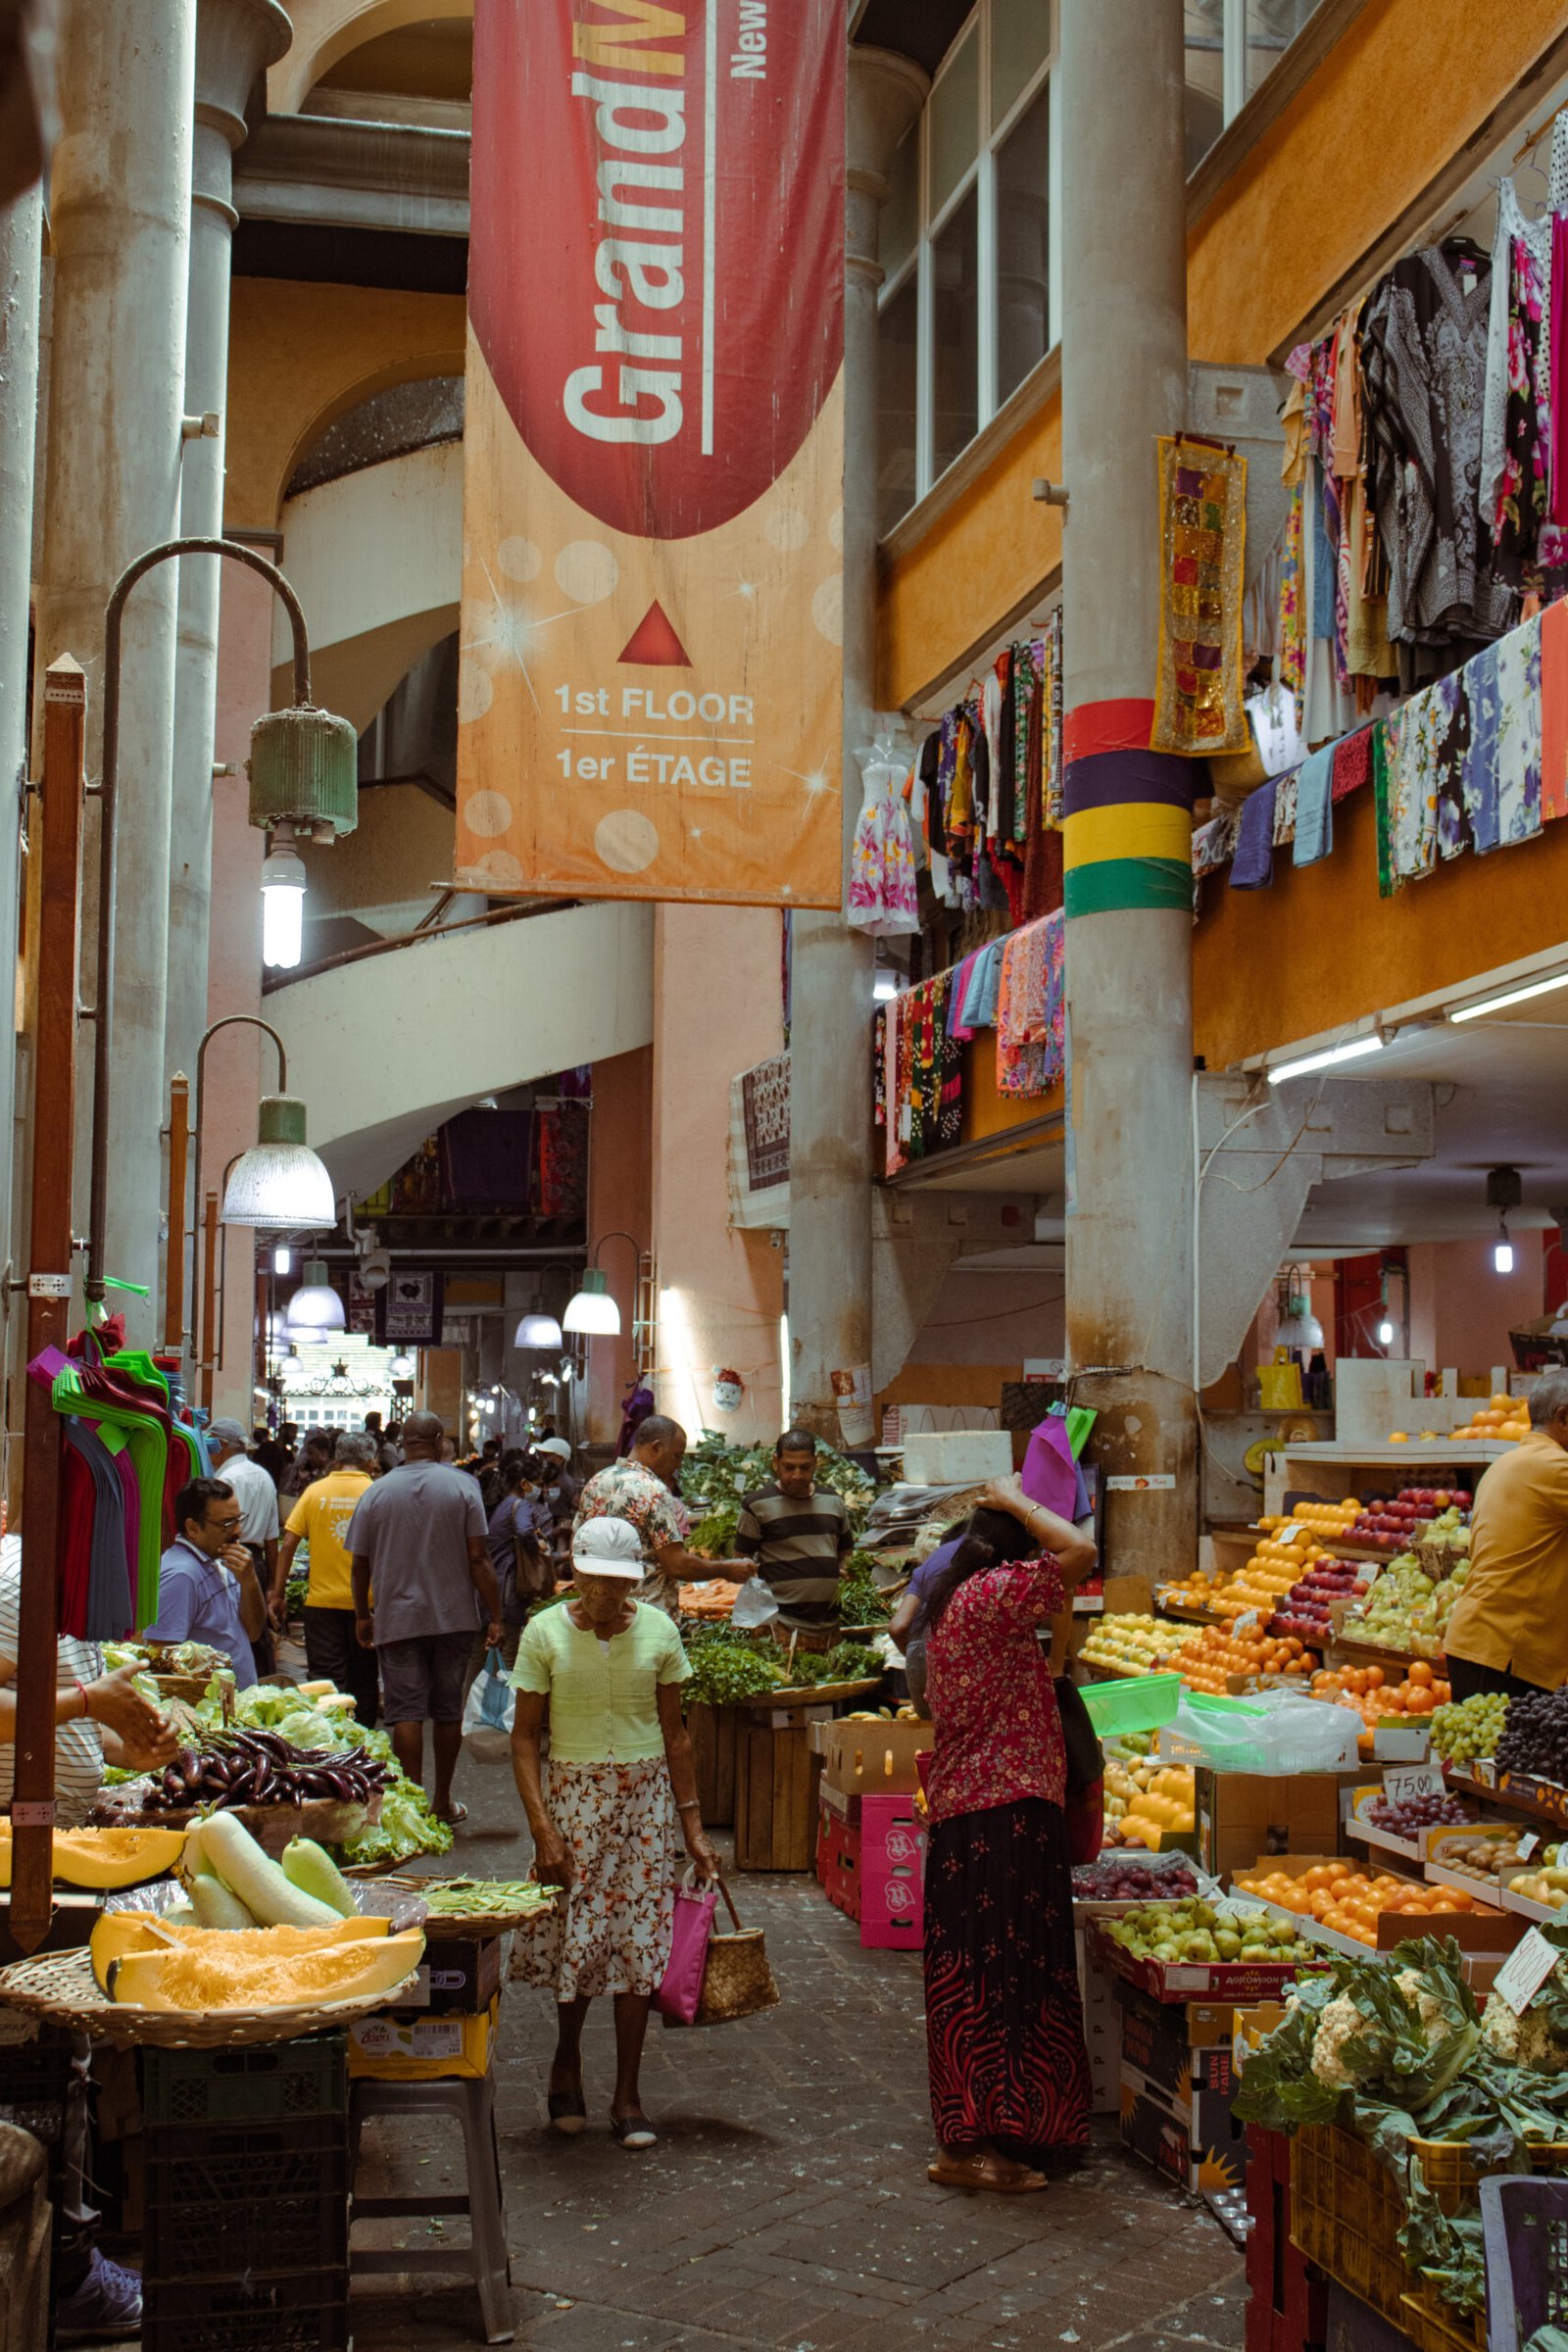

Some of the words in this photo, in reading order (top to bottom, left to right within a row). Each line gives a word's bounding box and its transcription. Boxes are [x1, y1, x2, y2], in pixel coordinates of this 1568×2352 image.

[730, 0, 767, 79] New
[555, 684, 610, 716] 1st
[621, 688, 755, 725] FLOOR
[557, 749, 615, 781] 1er
[626, 745, 754, 788] ÉTAGE
[1209, 2055, 1219, 2089] SUN
[1220, 2053, 1230, 2095] FARE
